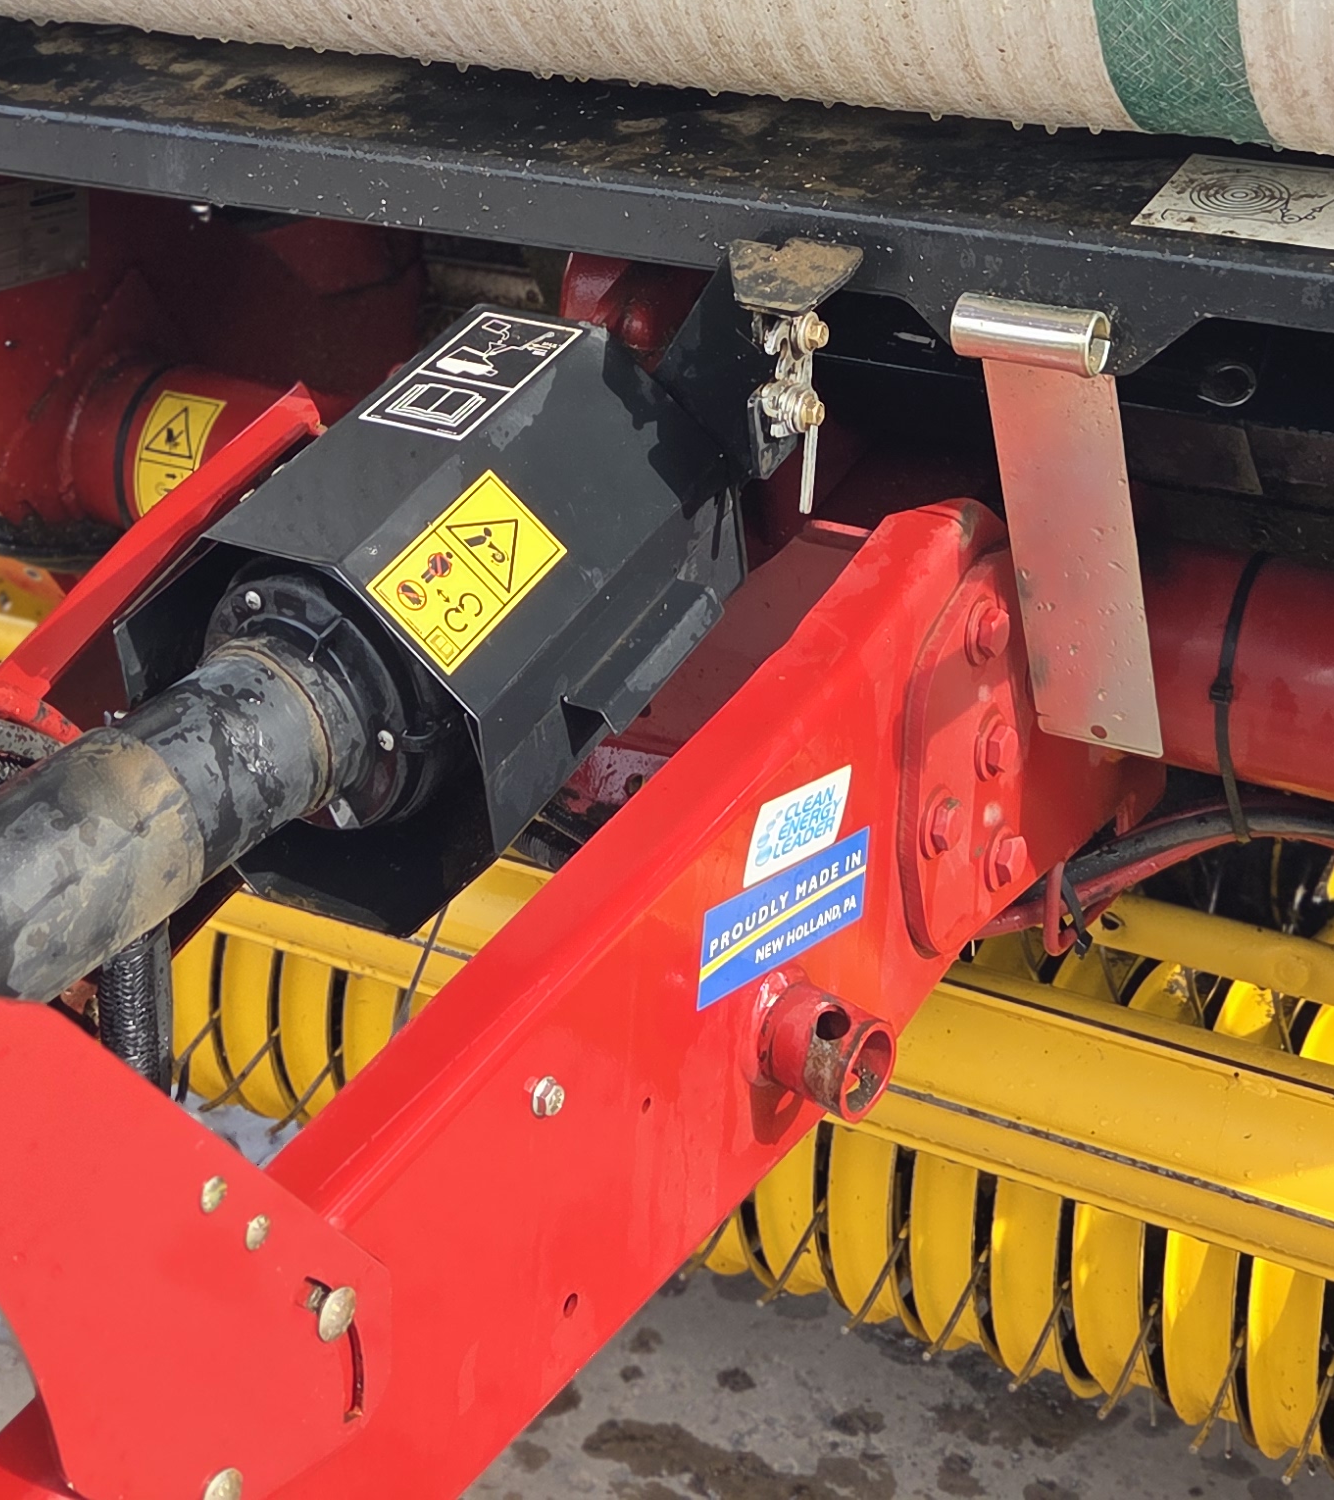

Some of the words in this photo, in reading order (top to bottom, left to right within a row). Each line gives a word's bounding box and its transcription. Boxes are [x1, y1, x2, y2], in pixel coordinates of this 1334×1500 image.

[778, 796, 843, 841] ENERGY
[785, 784, 836, 821] CLEAN
[773, 816, 835, 859] LEADER
[709, 891, 789, 958] PROUDLY
[795, 862, 839, 900] MADE
[845, 849, 862, 871] IN
[755, 935, 785, 964] NEW
[786, 904, 842, 947] HOLLAND,
[843, 895, 857, 914] PA
